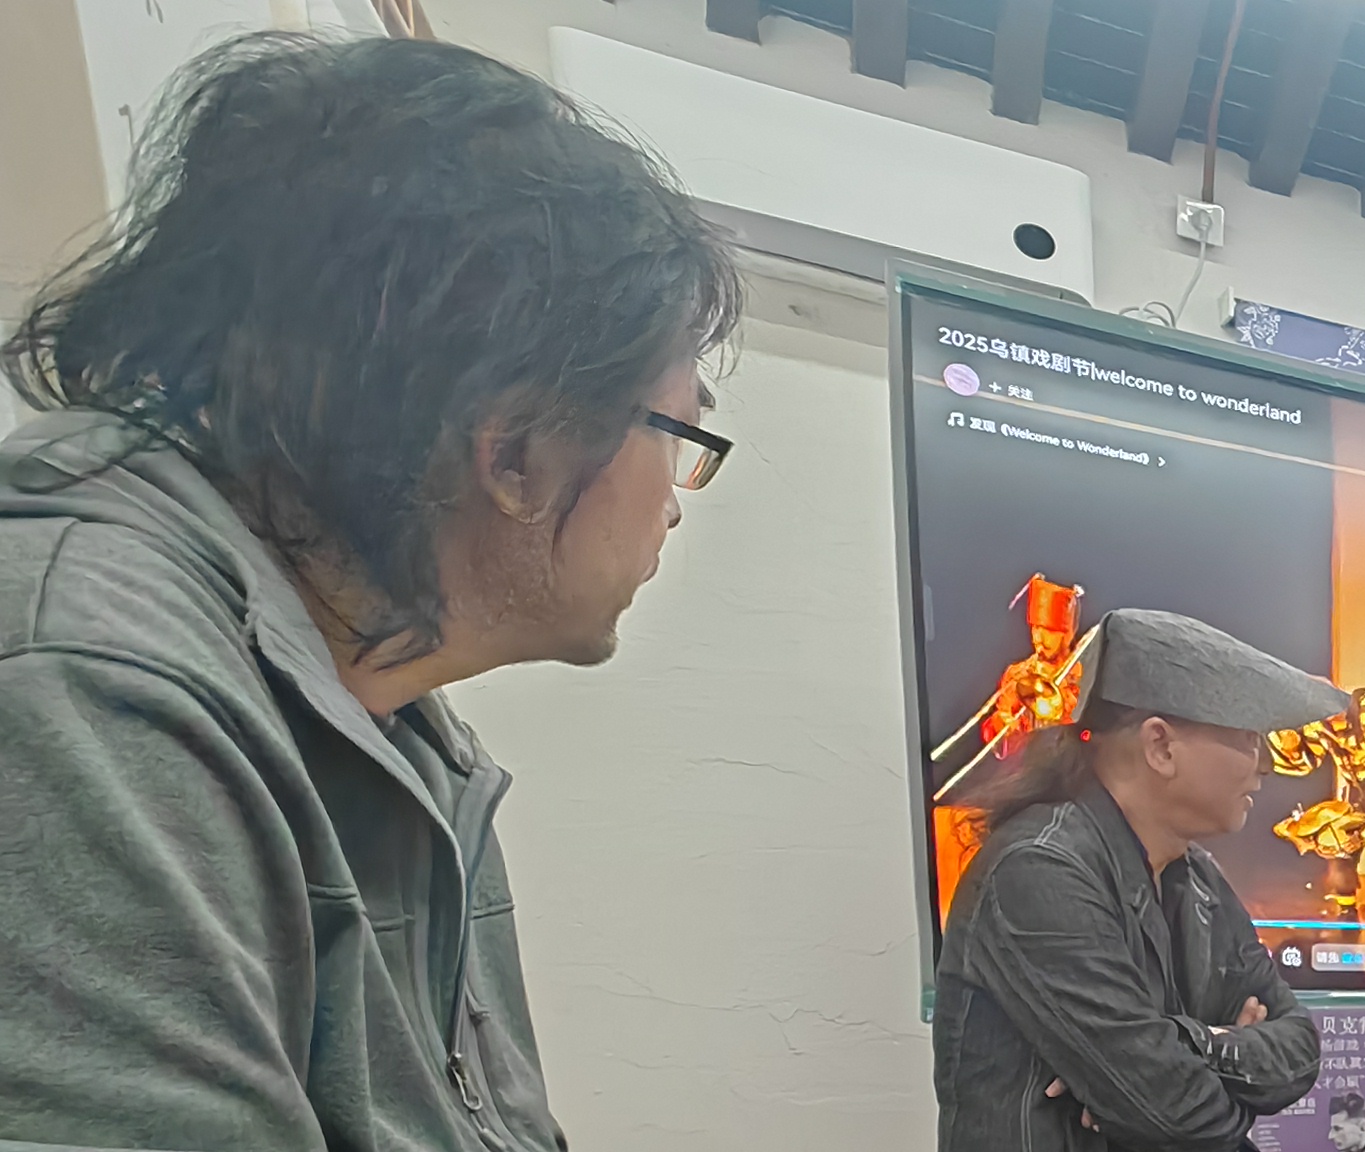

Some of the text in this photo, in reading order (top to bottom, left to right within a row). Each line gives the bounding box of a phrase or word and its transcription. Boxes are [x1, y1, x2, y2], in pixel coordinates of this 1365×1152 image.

[1178, 384, 1197, 402] to
[1201, 391, 1302, 425] wonderland
[1062, 438, 1075, 450] to
